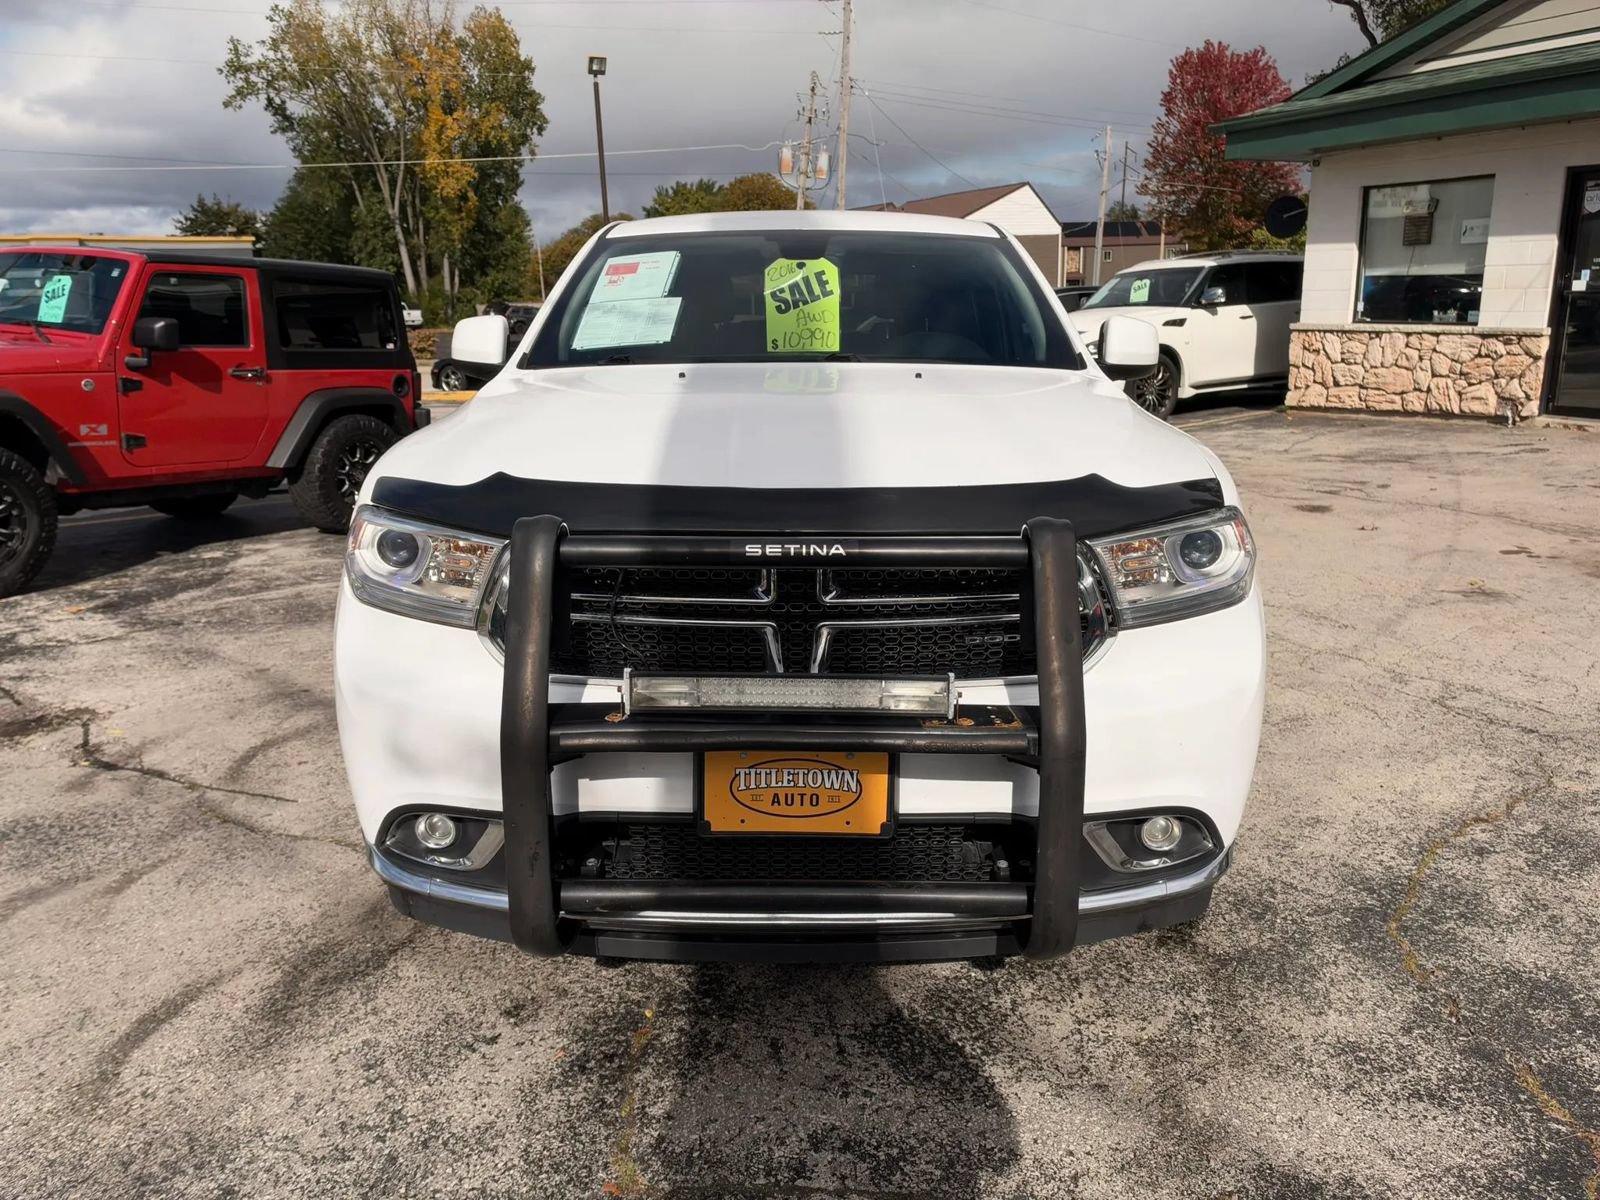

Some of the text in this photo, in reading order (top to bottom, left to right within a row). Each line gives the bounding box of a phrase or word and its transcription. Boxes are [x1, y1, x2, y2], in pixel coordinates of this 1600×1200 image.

[44, 284, 66, 304] SALE
[770, 270, 834, 315] SALE
[1133, 282, 1147, 293] SALE
[796, 308, 835, 328] AWD
[745, 544, 847, 556] SETINA
[735, 767, 859, 793] TITLETOWN
[771, 793, 820, 807] AUTO
